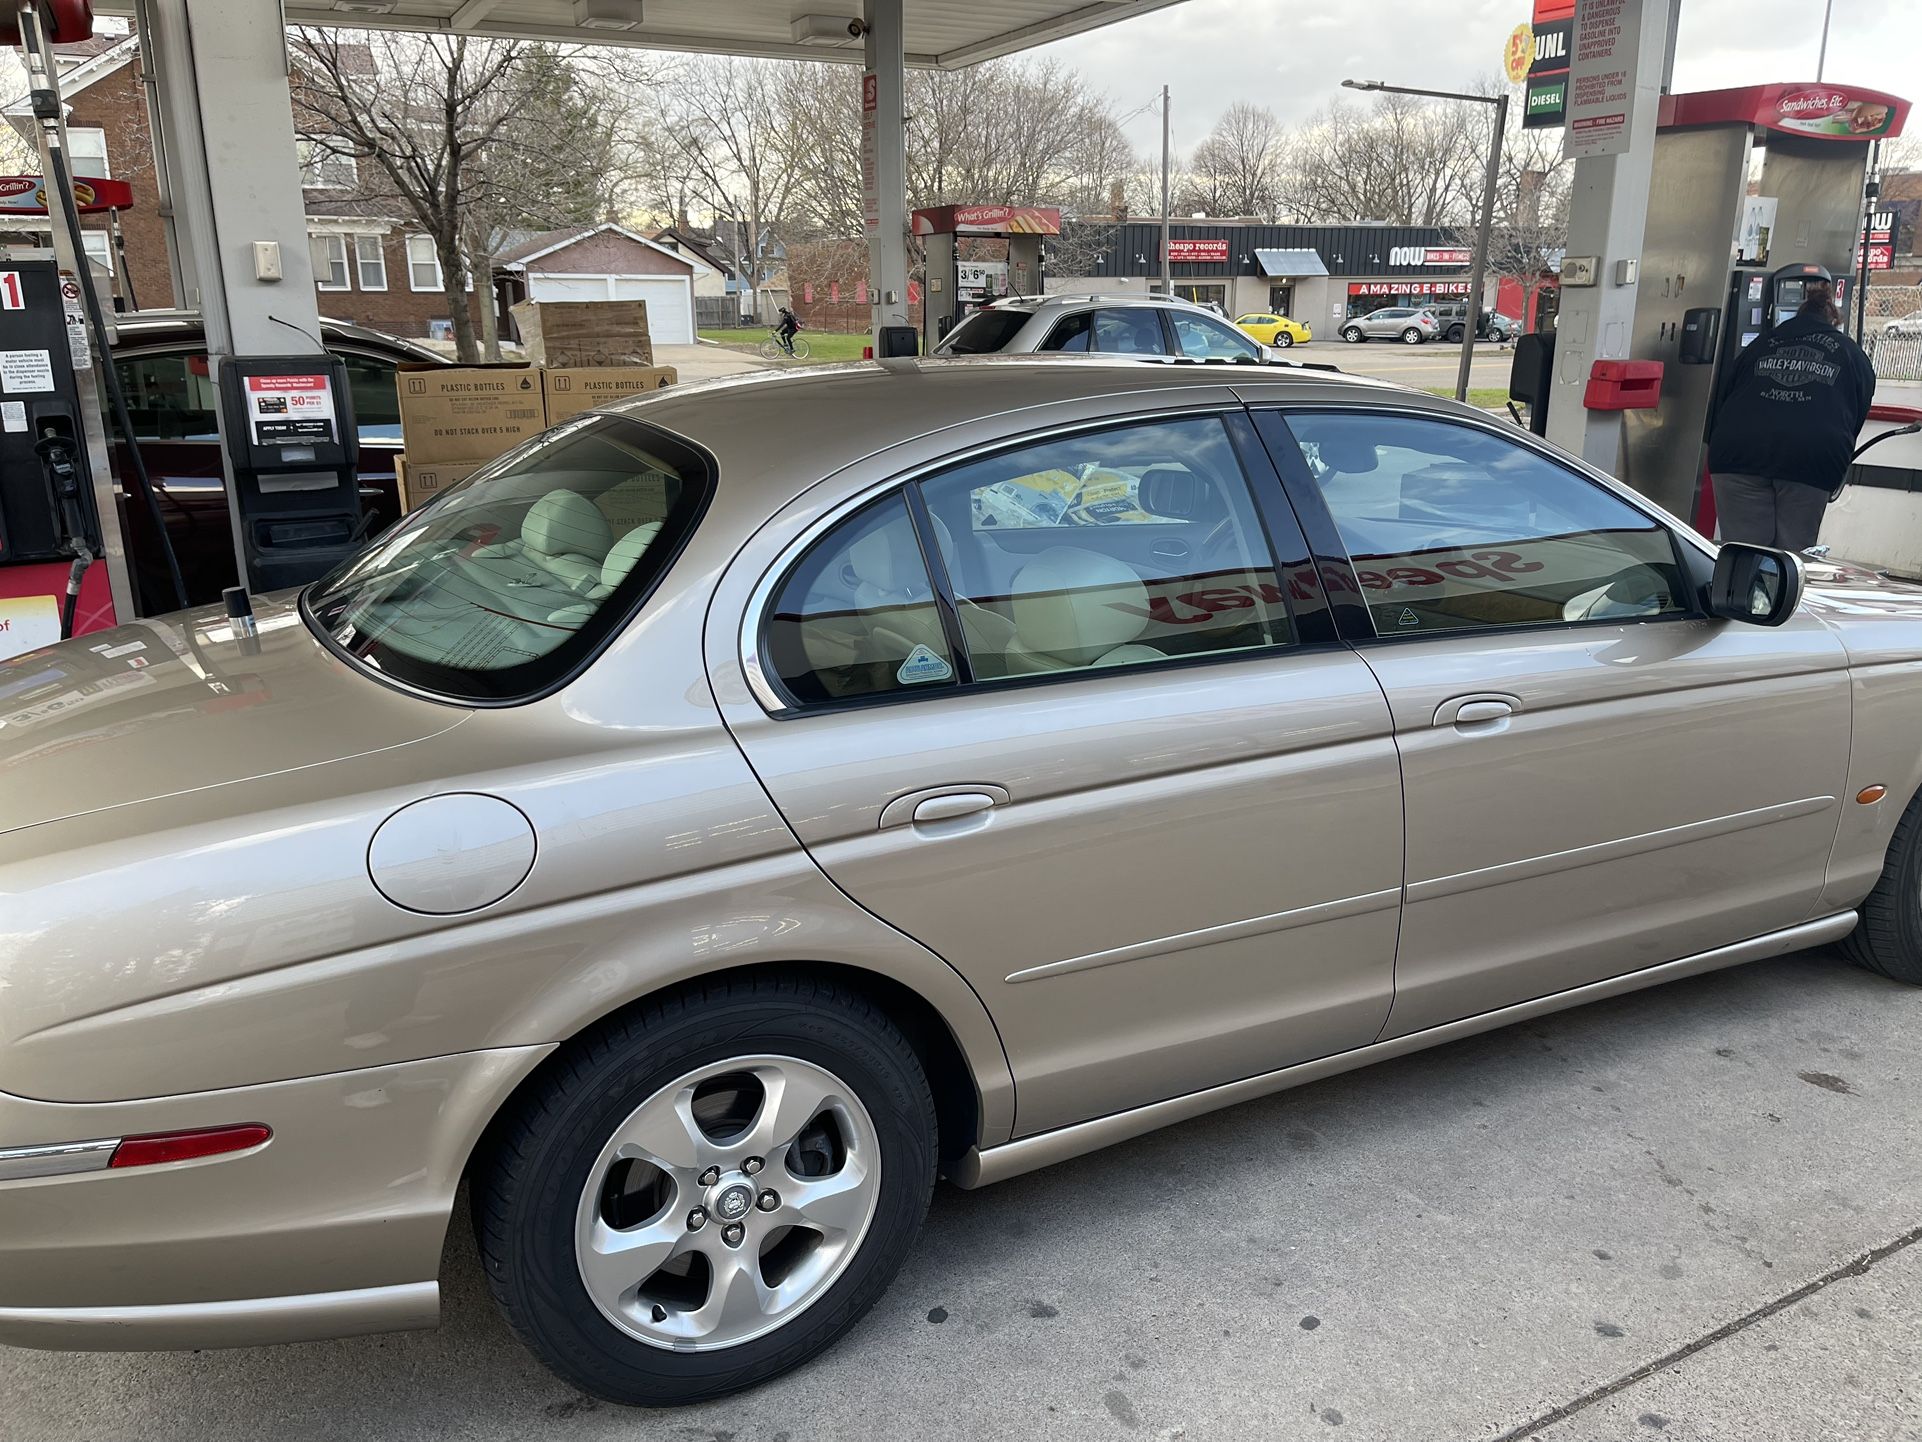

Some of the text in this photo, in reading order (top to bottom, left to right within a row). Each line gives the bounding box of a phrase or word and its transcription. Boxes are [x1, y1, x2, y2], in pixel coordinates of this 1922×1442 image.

[1587, 6, 1621, 20] DANGEROUS
[1581, 17, 1616, 31] TO DISPENSE
[1580, 26, 1621, 41] GASOLINE INTO
[1534, 32, 1566, 60] UNL
[1579, 37, 1616, 52] UNAPPROVED
[1531, 93, 1561, 107] DIESEL
[957, 211, 982, 222] What's
[1195, 242, 1227, 250] records
[4, 273, 20, 308] 1
[1360, 282, 1472, 294] AMAZING E-BIKES
[1836, 280, 1844, 299] 3
[1759, 358, 1836, 378] HARLEY-DAVIDSON
[441, 382, 506, 392] PLASTIC BOTTLES
[584, 381, 645, 390] PLASTIC BOTTLES
[291, 396, 306, 406] 50
[434, 429, 443, 437] DO
[445, 428, 457, 436] NOT
